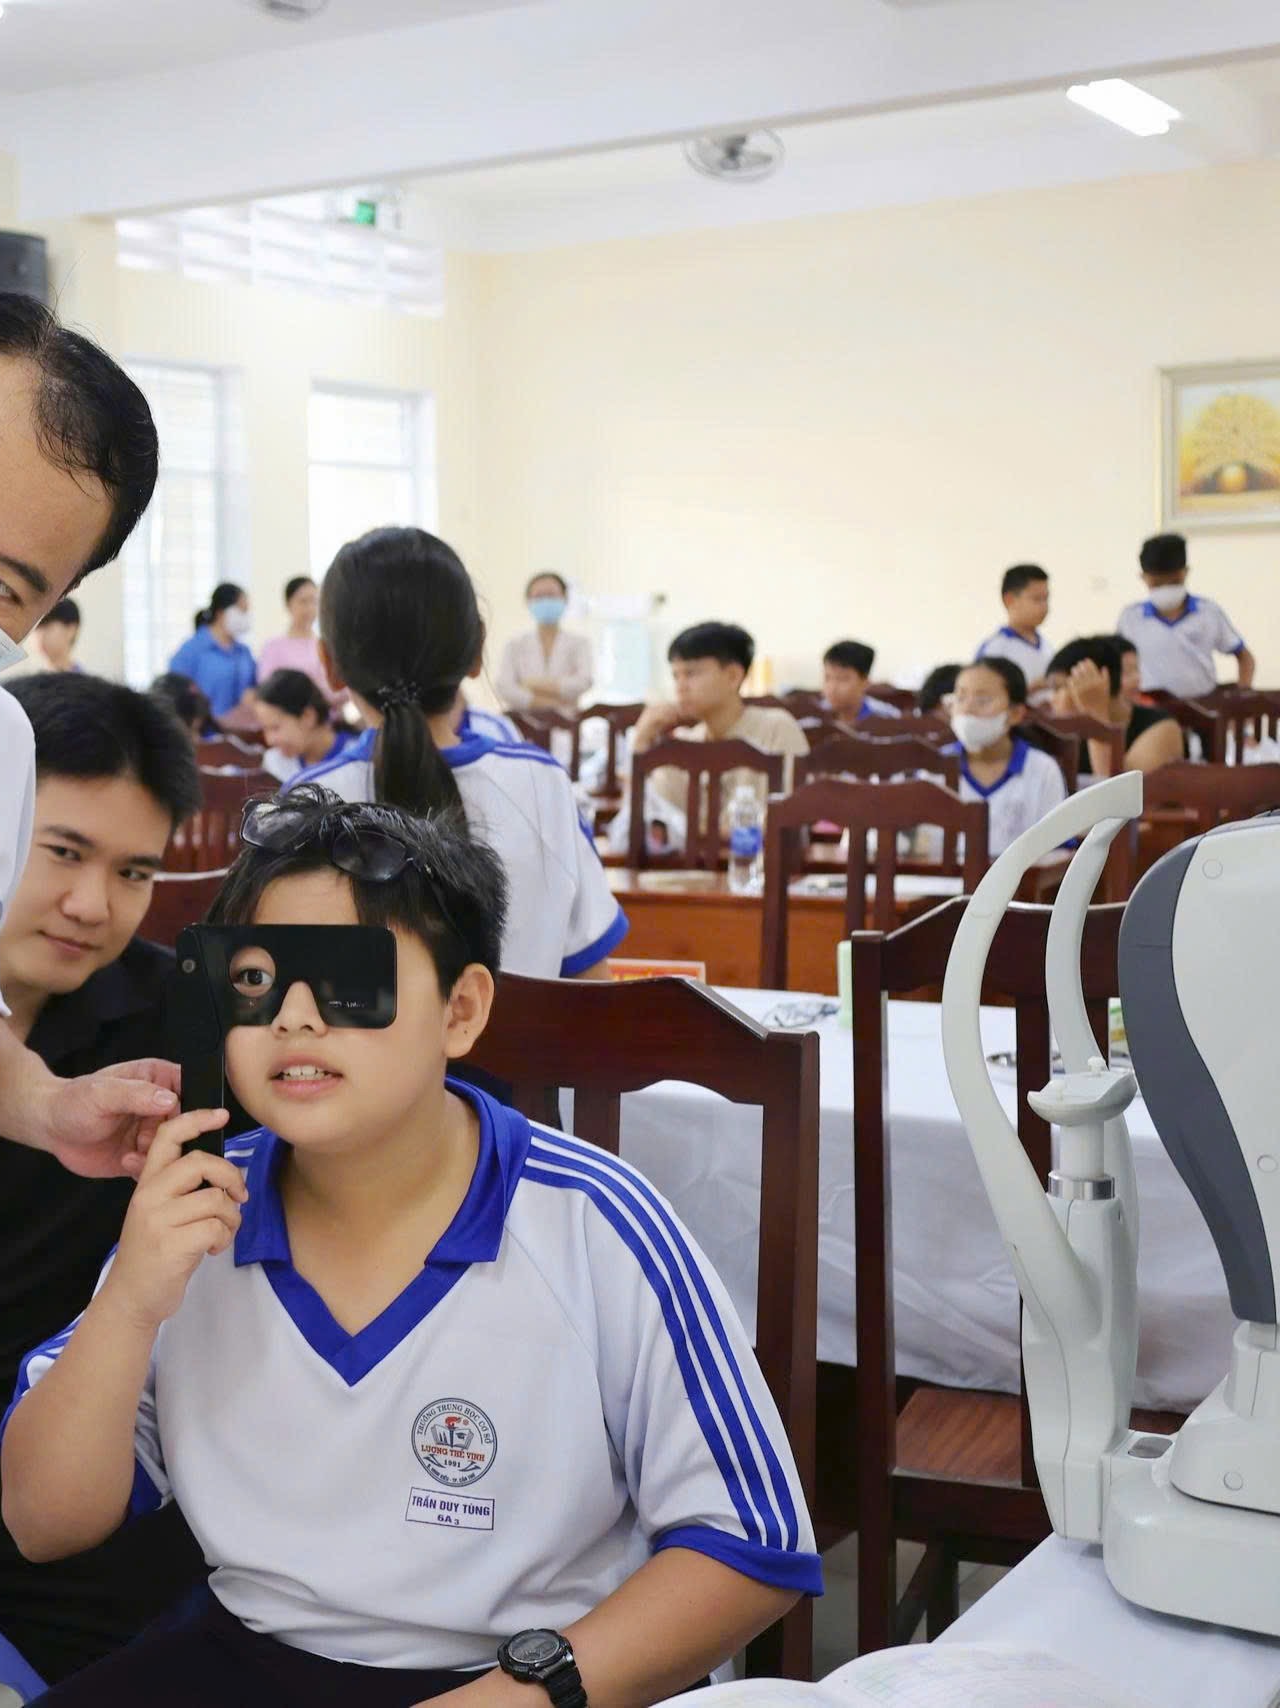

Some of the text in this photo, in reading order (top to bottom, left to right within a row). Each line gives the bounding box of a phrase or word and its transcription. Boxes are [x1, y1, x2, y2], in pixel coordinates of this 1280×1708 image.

[437, 1403, 462, 1412] TRUNG
[466, 1452, 485, 1461] VINH
[444, 1459, 461, 1468] 1991
[439, 1500, 460, 1512] DUY
